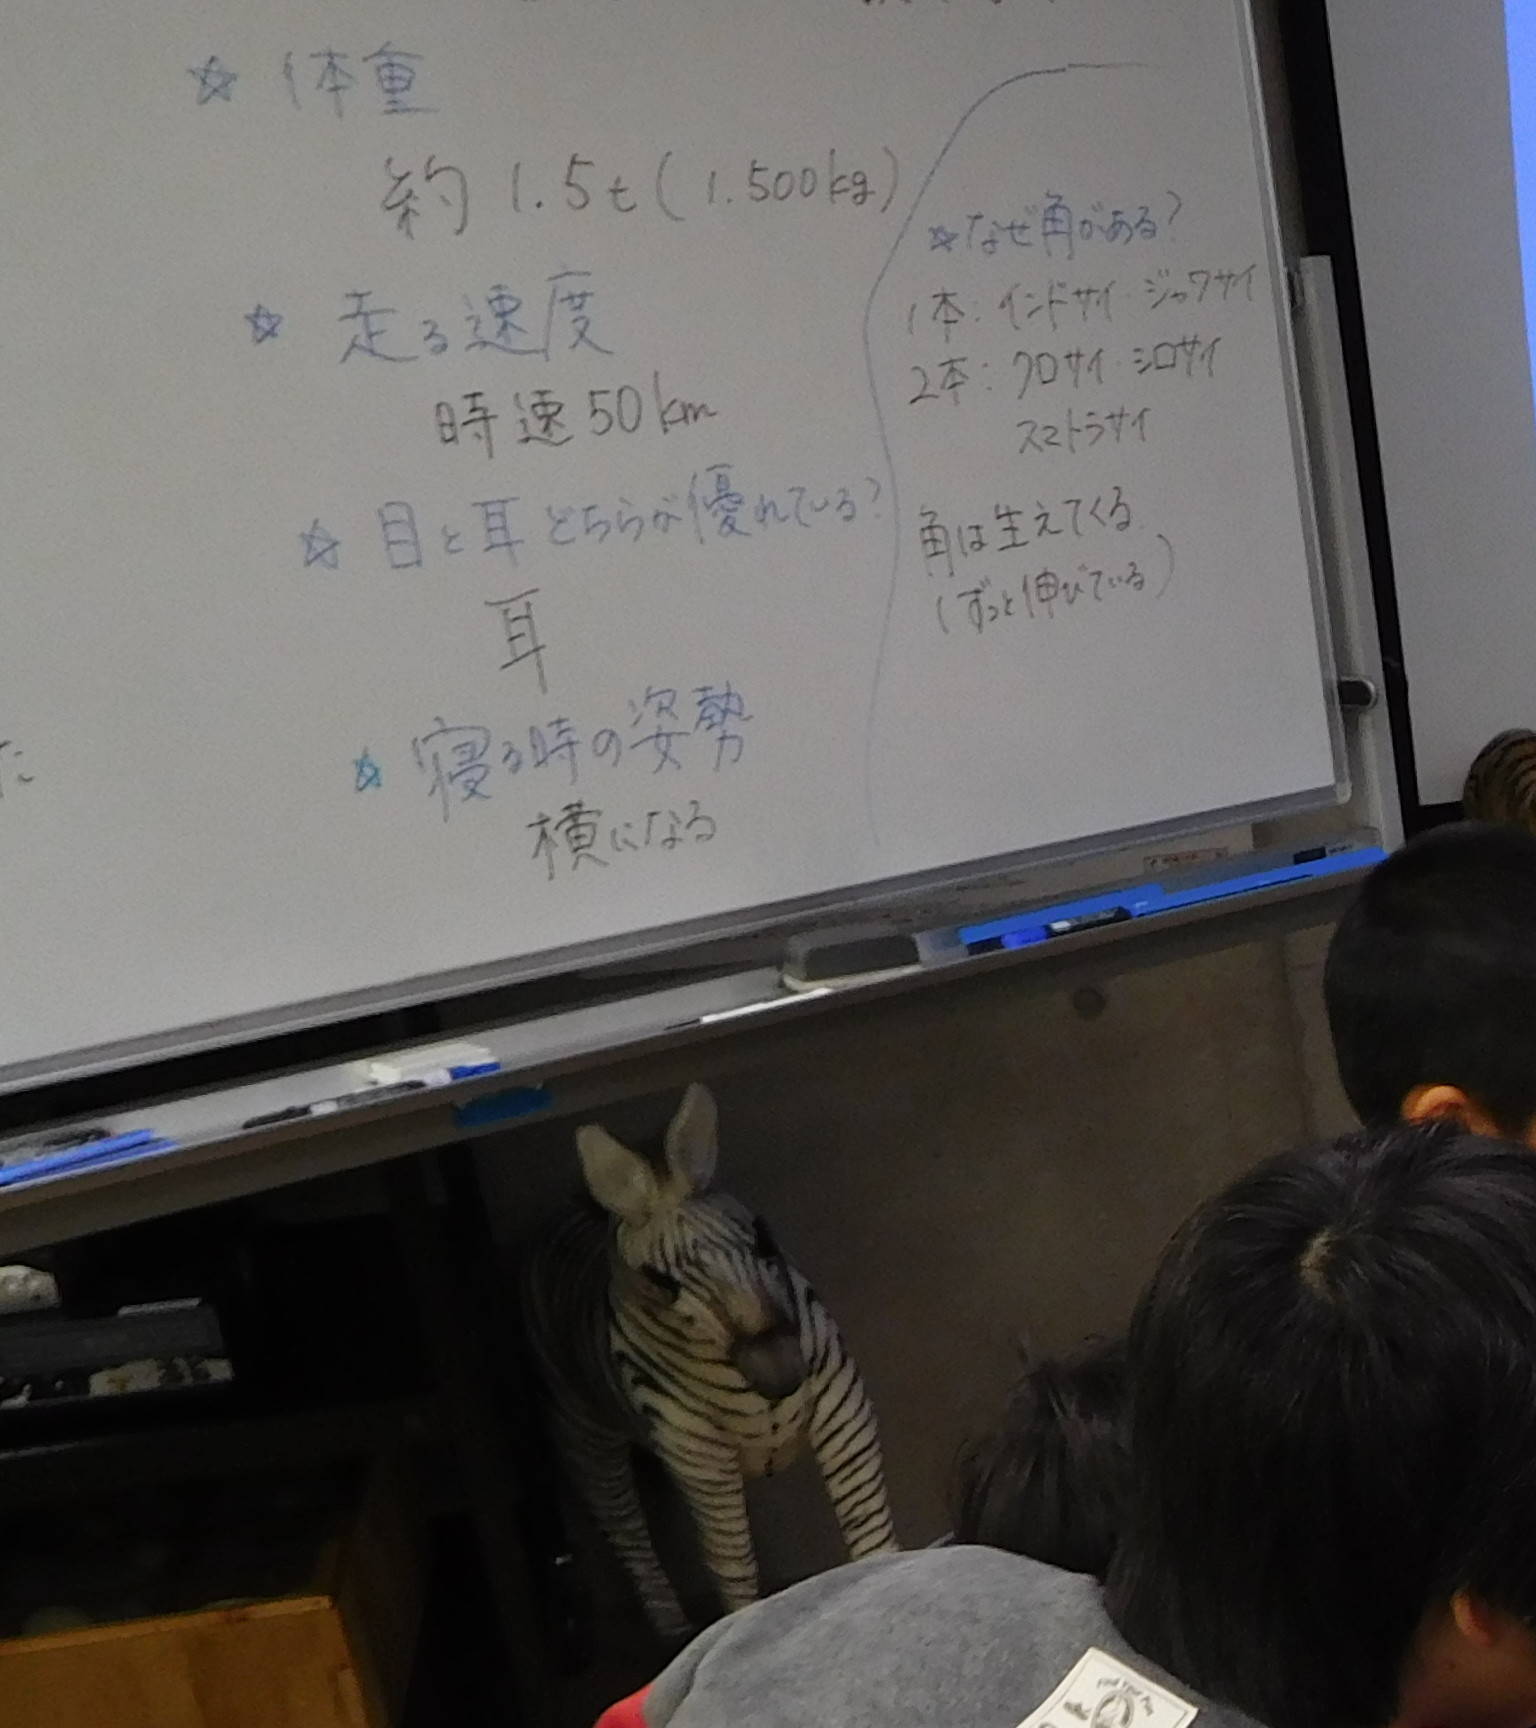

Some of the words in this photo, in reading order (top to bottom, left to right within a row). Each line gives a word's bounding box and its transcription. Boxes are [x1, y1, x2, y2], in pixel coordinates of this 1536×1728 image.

[282, 42, 440, 118] 体重
[339, 267, 615, 366] 走る速度
[484, 588, 548, 695] 耳
[411, 682, 755, 823] 寝る時の姿勢
[526, 800, 719, 882] 横になる
